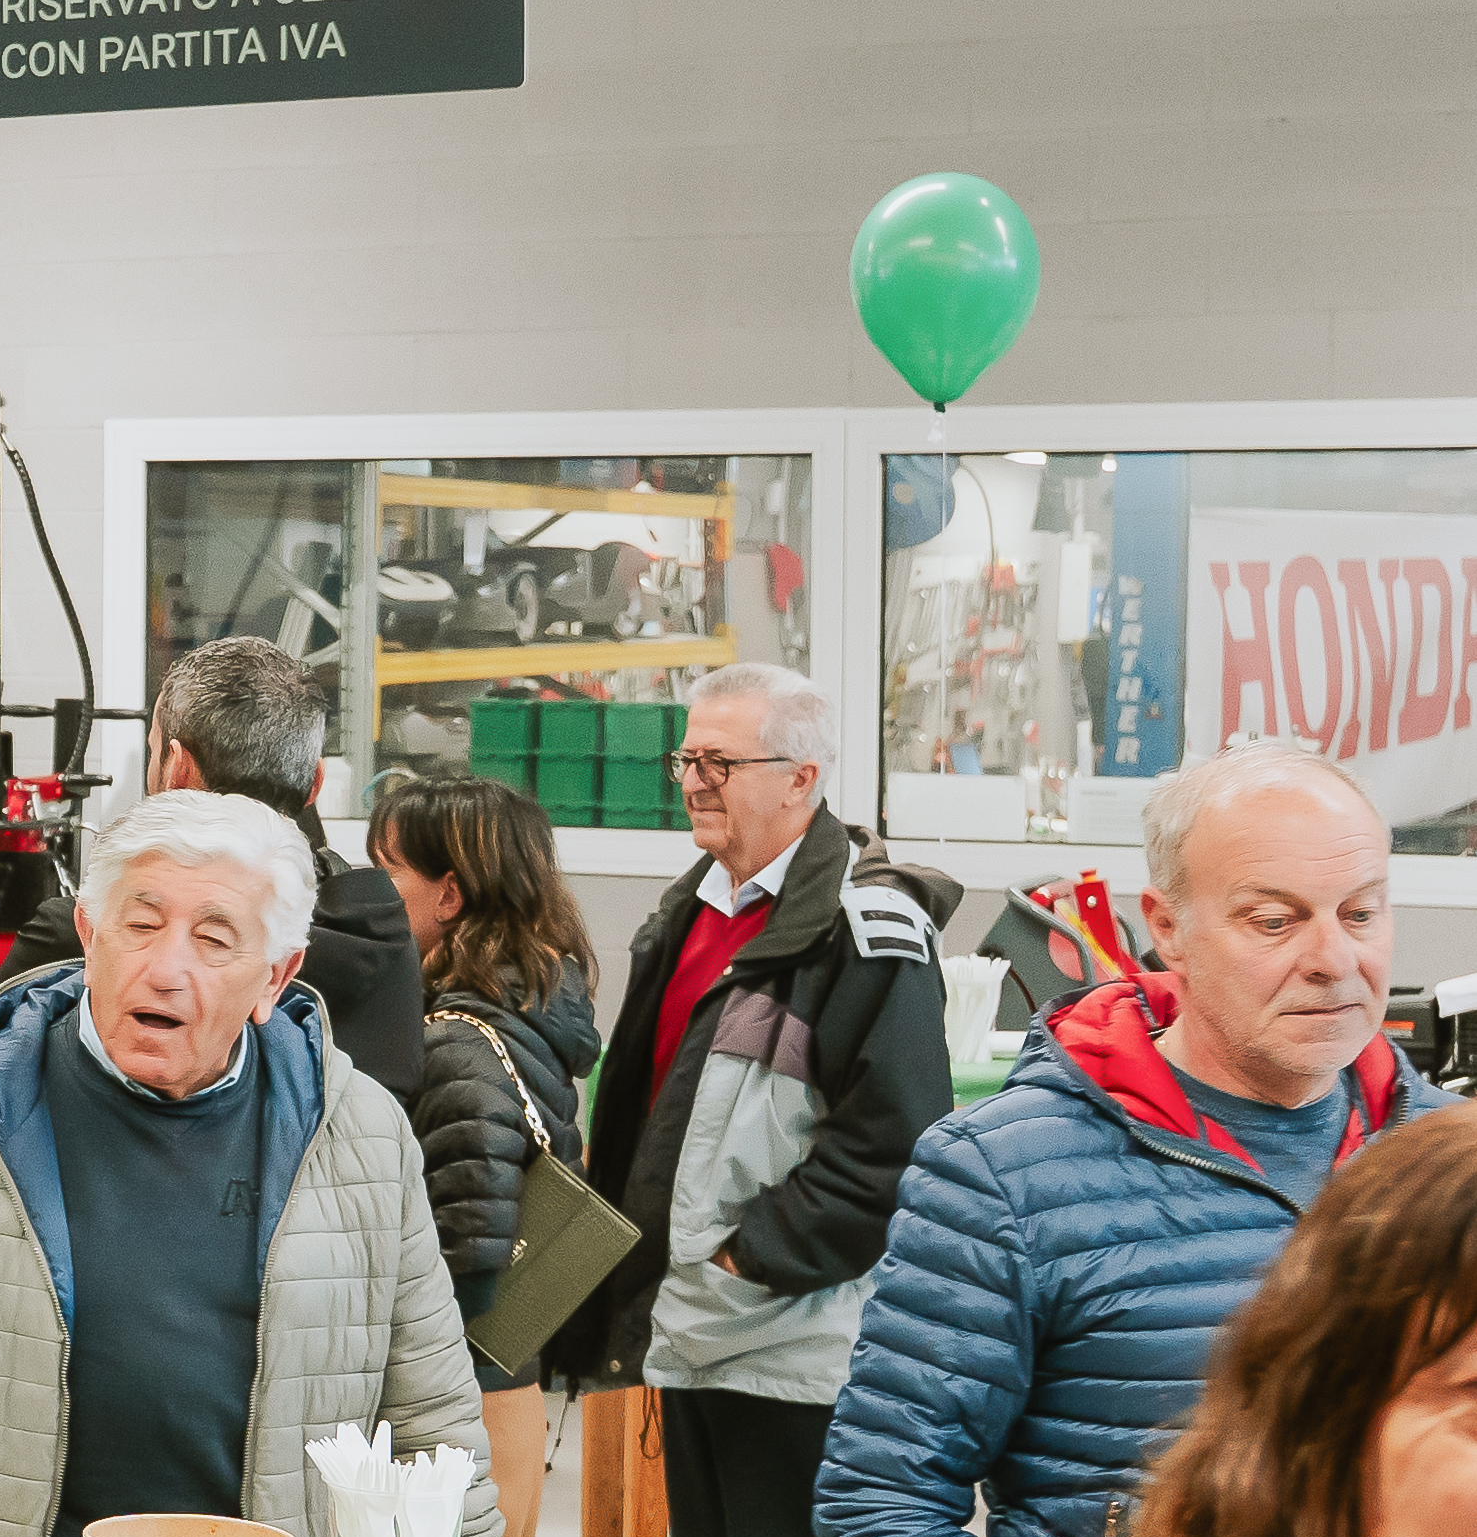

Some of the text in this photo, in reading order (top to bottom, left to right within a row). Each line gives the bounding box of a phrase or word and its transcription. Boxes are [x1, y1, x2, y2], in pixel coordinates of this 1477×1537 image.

[1, 21, 347, 79] CON PARTITA IVA
